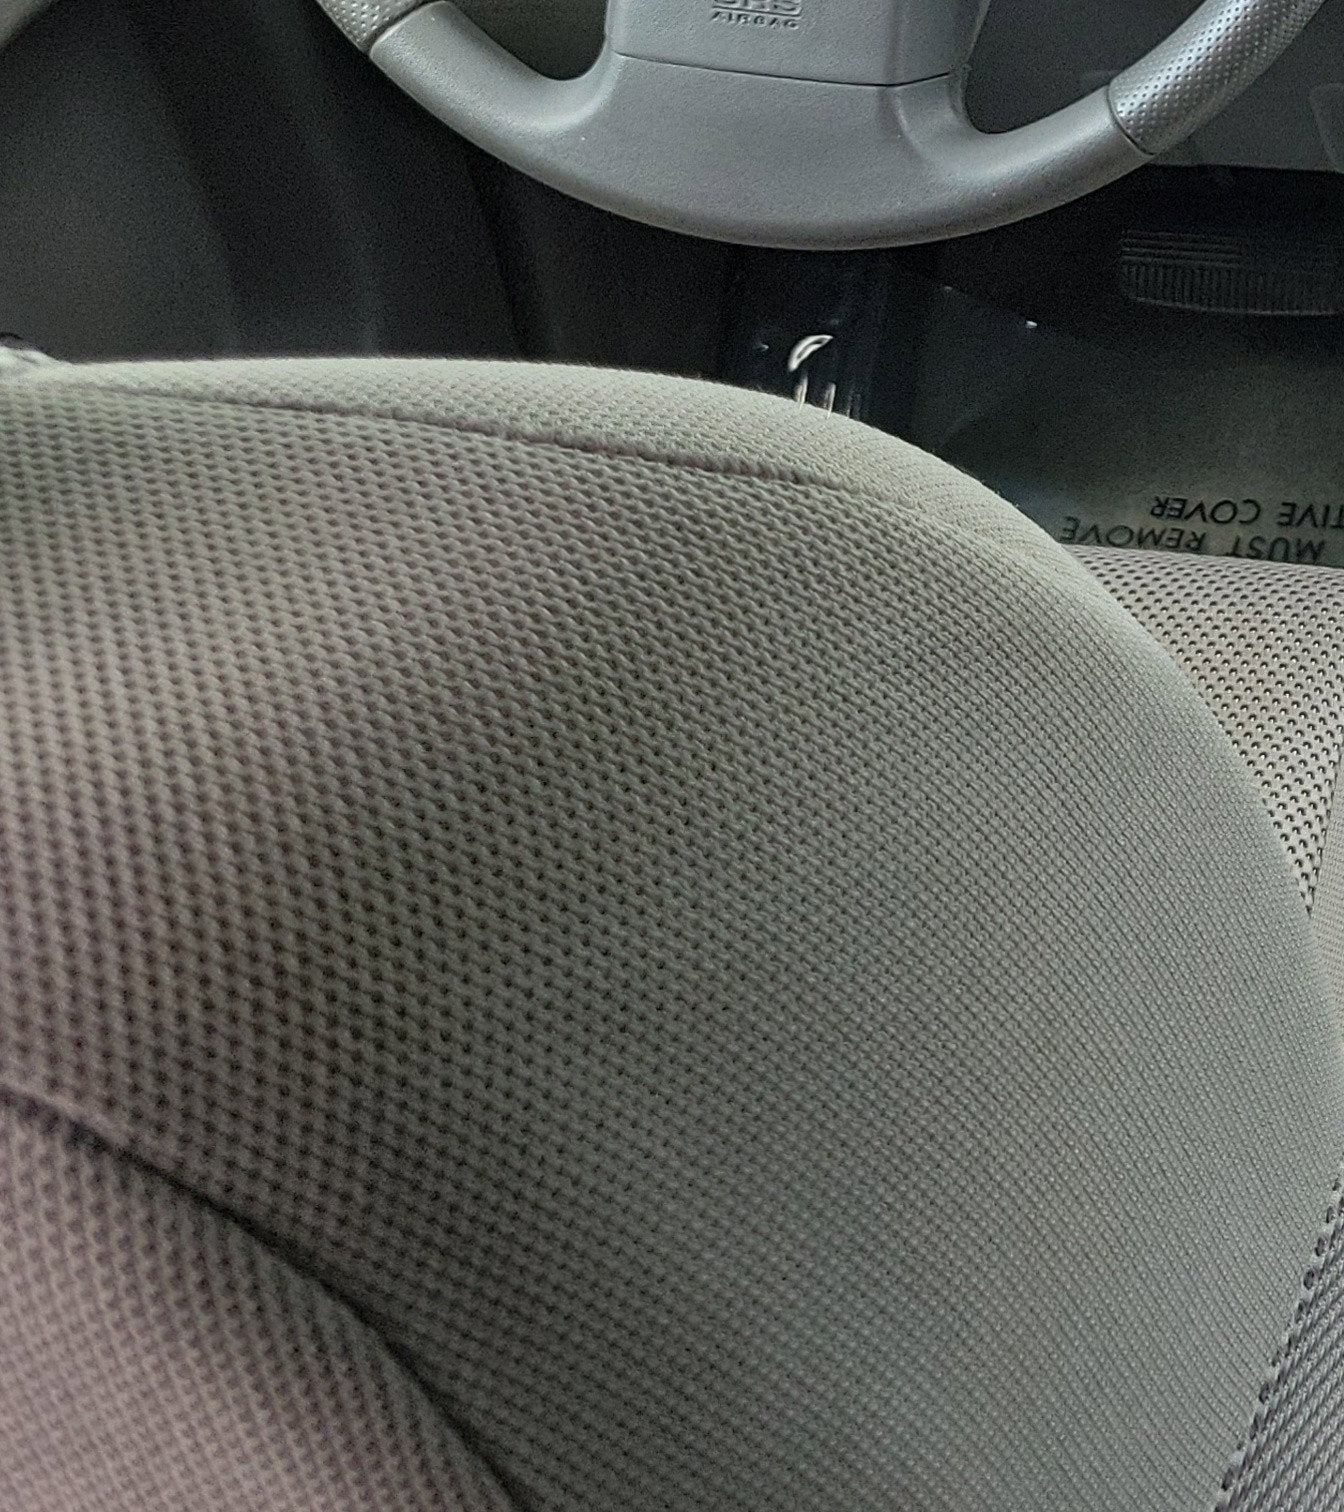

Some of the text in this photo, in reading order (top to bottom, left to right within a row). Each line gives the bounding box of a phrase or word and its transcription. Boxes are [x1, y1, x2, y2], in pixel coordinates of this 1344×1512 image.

[1149, 495, 1261, 525] COVER
[1061, 515, 1207, 552] REMOVE
[1227, 536, 1325, 563] MUST
